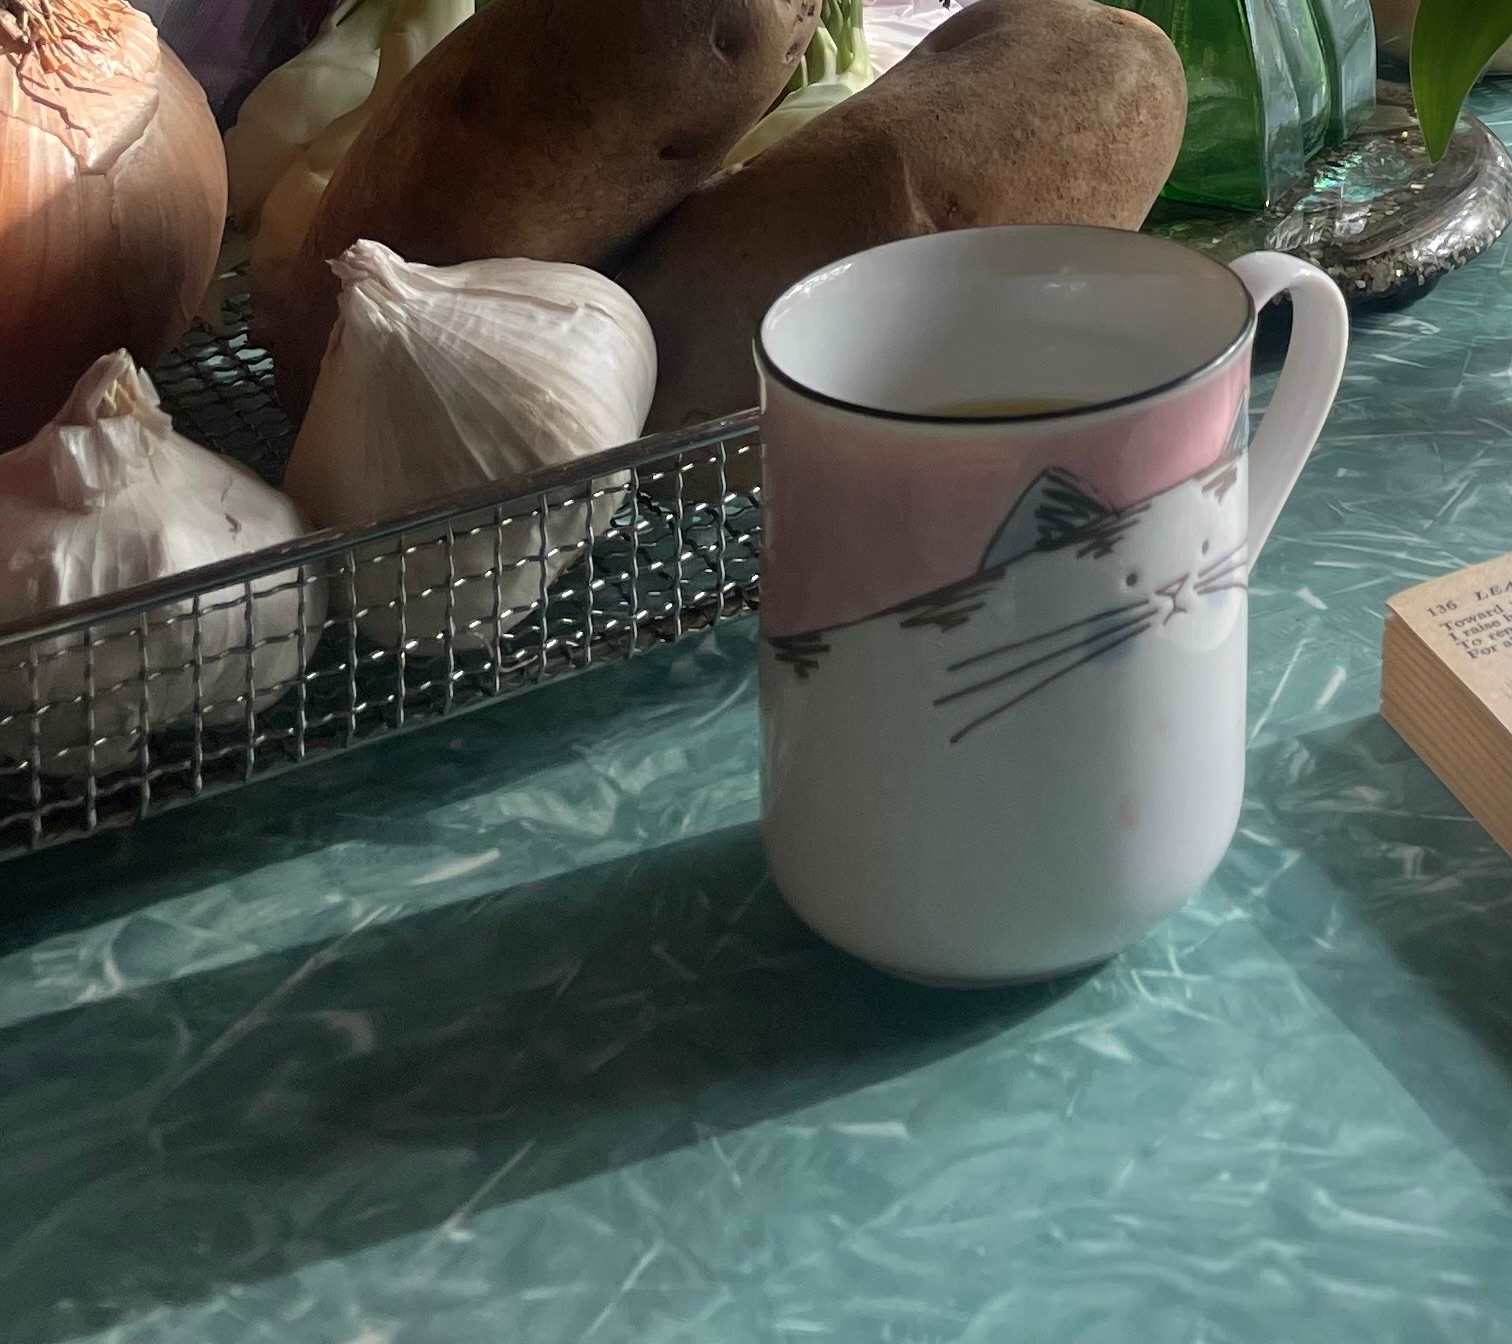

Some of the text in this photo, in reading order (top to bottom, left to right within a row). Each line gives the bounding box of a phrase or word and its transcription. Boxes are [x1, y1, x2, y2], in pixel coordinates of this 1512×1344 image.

[1427, 600, 1458, 616] 136
[1439, 604, 1504, 631] Toward
[1449, 632, 1458, 640] I
[1462, 620, 1501, 636] raise
[1456, 638, 1482, 649] To
[1467, 645, 1497, 658] For
